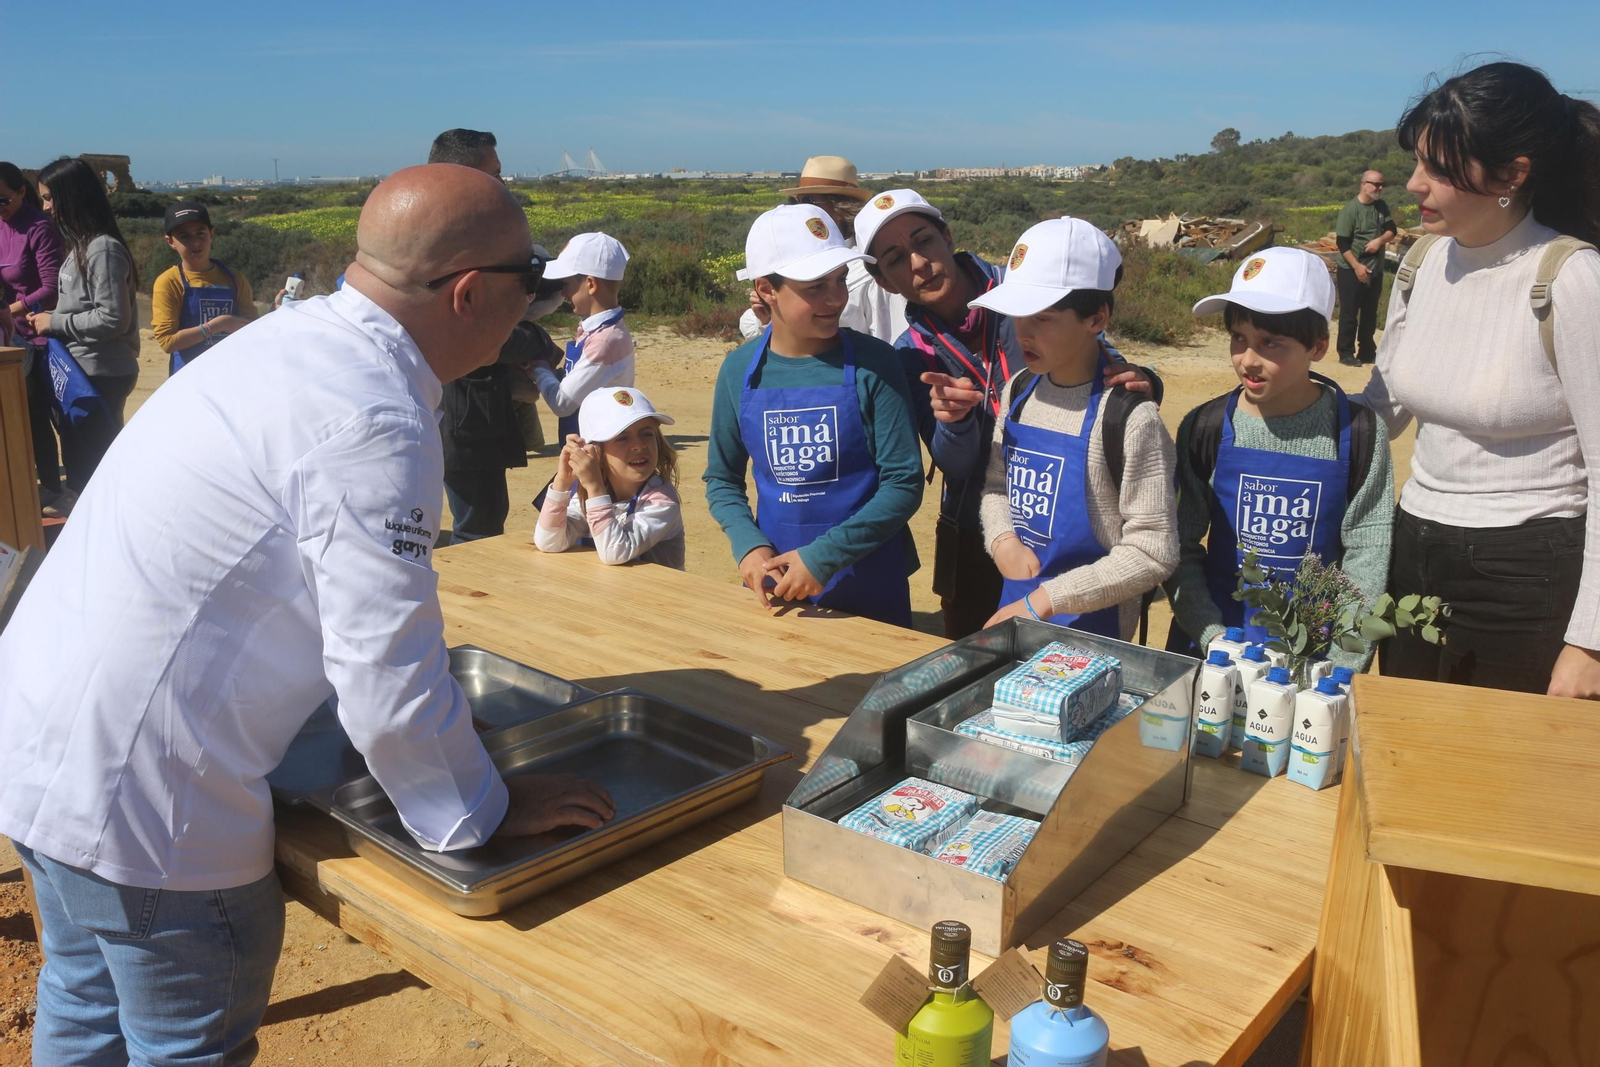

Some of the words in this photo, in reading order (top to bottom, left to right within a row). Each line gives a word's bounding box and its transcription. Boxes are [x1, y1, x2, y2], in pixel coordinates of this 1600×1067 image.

[768, 413, 799, 424] sabor
[769, 426, 778, 436] a
[779, 414, 833, 445] má
[770, 439, 834, 471] laga
[1013, 463, 1053, 494] má
[1244, 480, 1278, 492] sabor
[1009, 477, 1049, 519] laga
[1243, 491, 1252, 502] a
[1253, 488, 1312, 518] má
[1241, 505, 1309, 544] laga
[1241, 532, 1266, 541] PRODUCTOS
[1199, 705, 1217, 715] GUA
[1249, 721, 1274, 734] AGUA
[1295, 731, 1318, 744] AGUA
